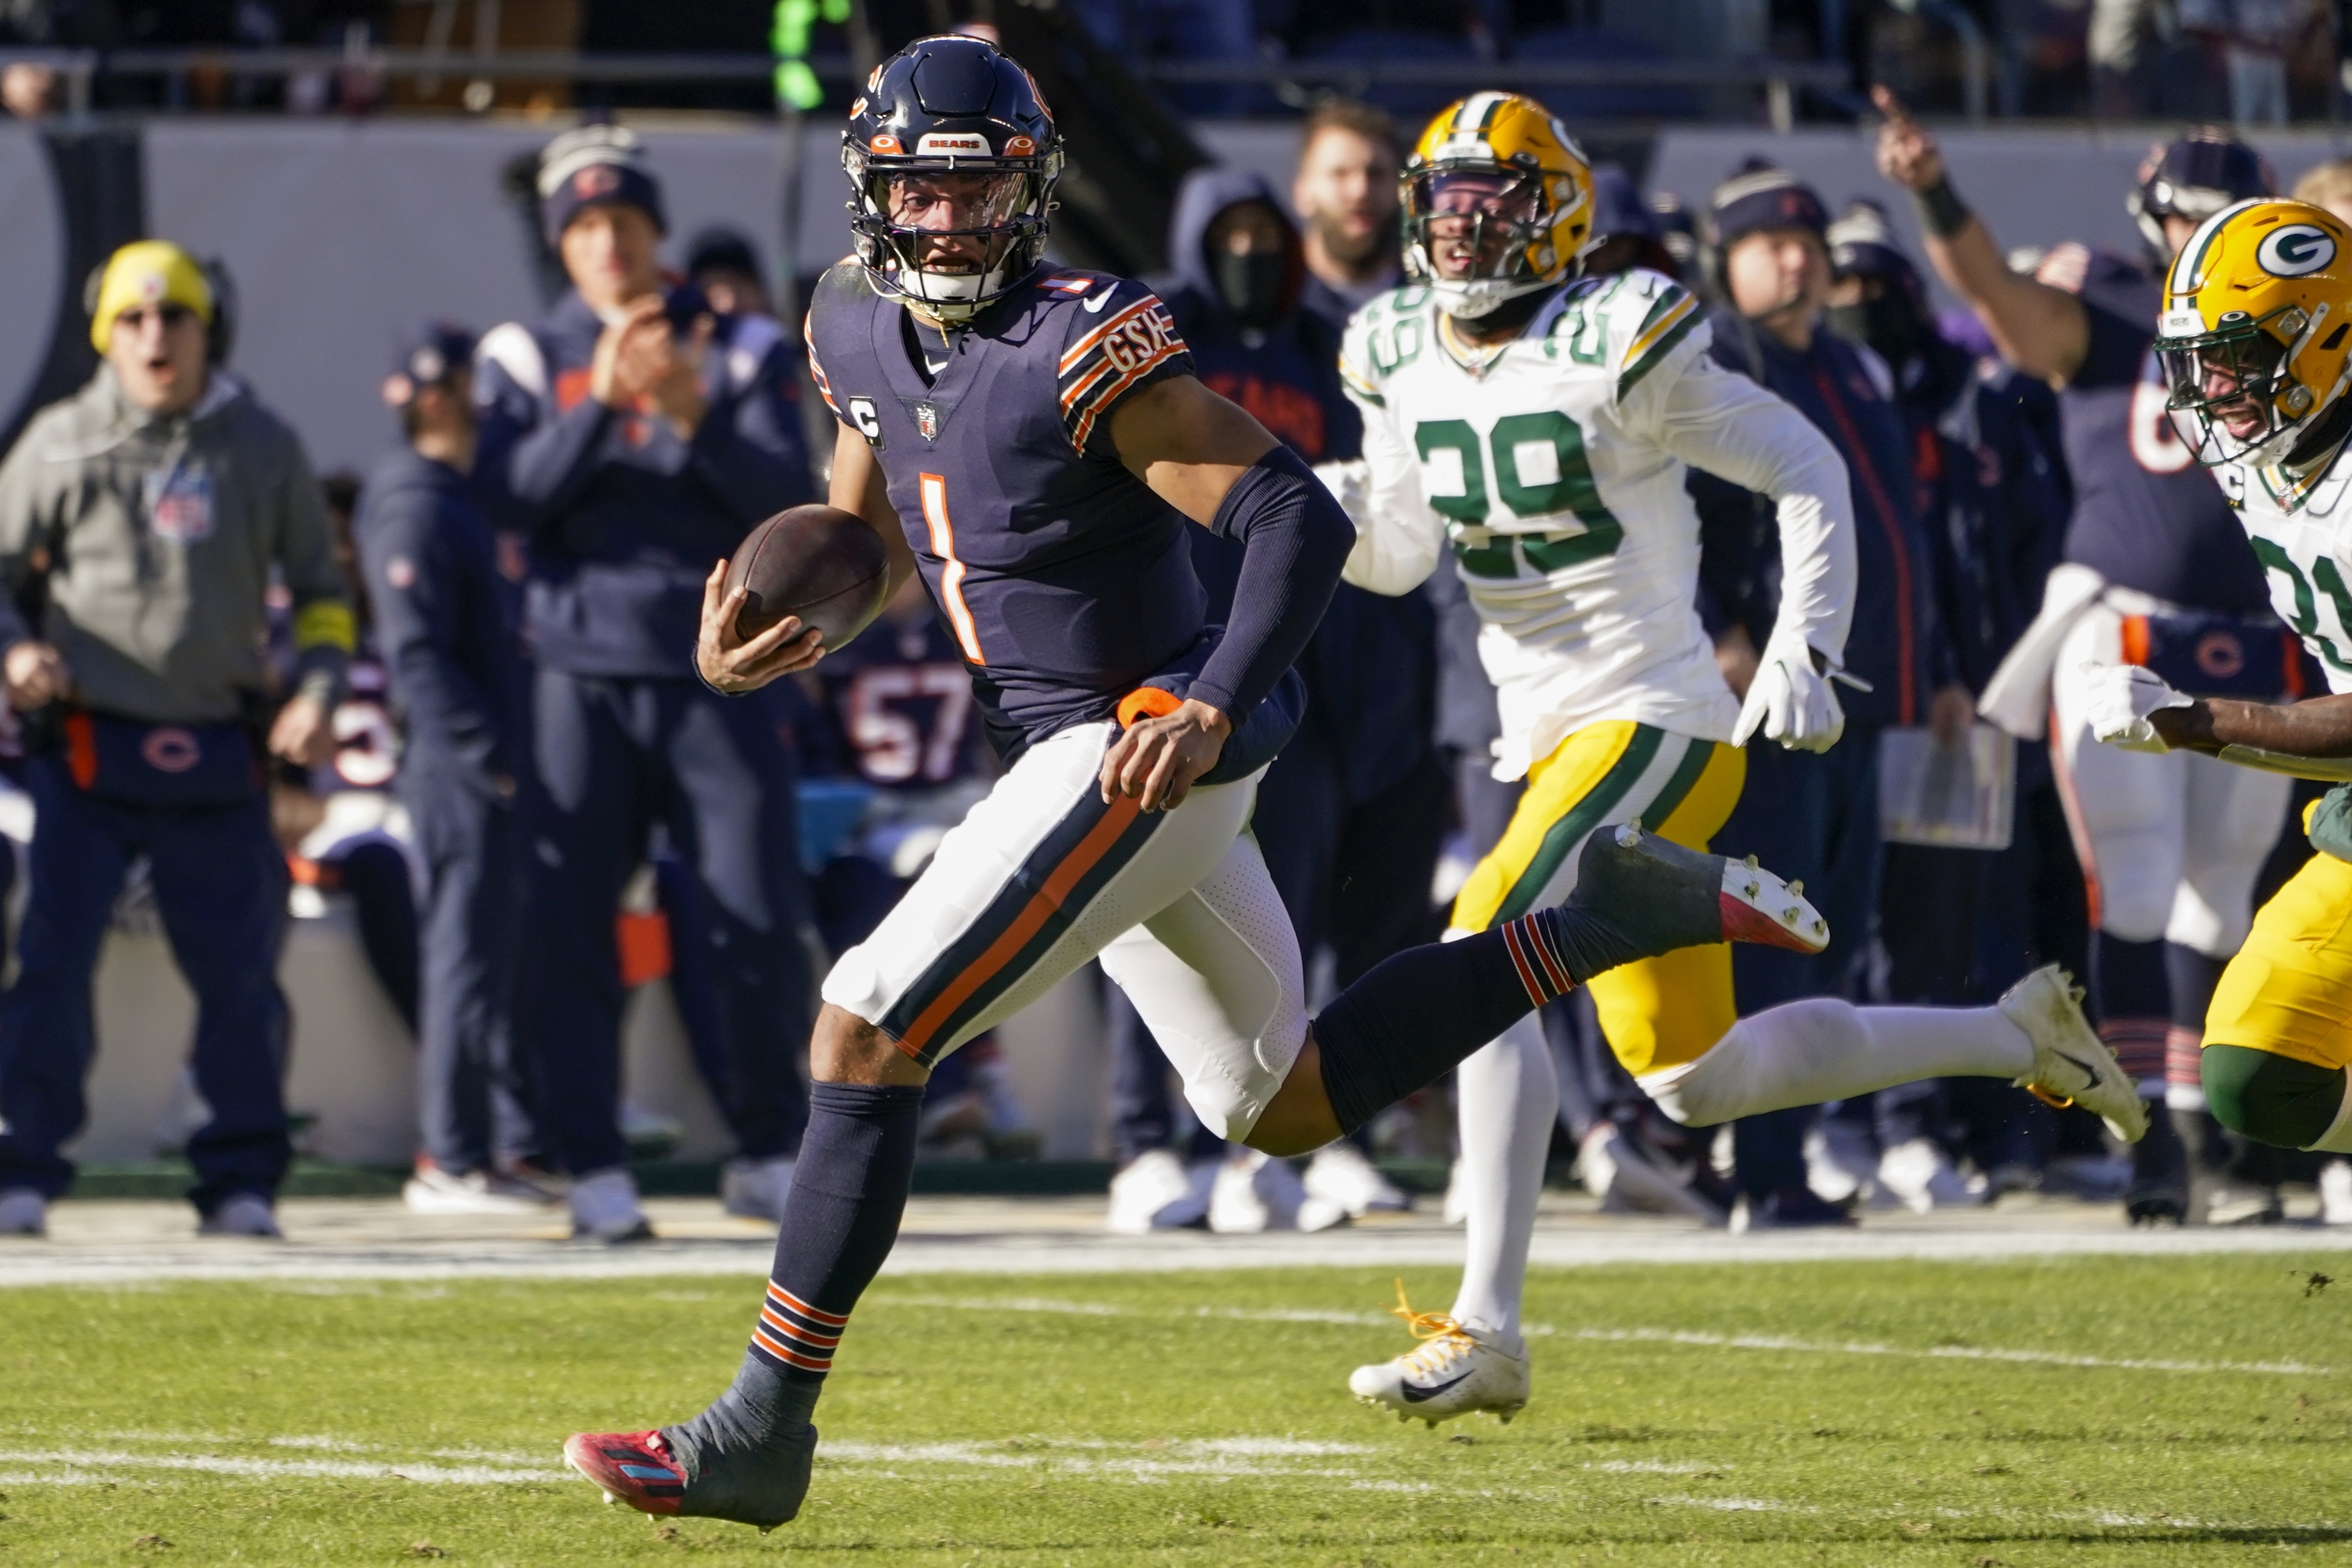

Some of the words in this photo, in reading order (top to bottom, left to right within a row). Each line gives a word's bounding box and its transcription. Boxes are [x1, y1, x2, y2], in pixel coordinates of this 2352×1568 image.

[929, 140, 980, 149] BEARS
[2258, 224, 2336, 277] G
[1102, 308, 1173, 374] GSH
[850, 400, 879, 438] C
[1414, 410, 1625, 579] 29
[2223, 463, 2244, 501] C
[919, 472, 986, 666] 1
[847, 664, 974, 781] 57
